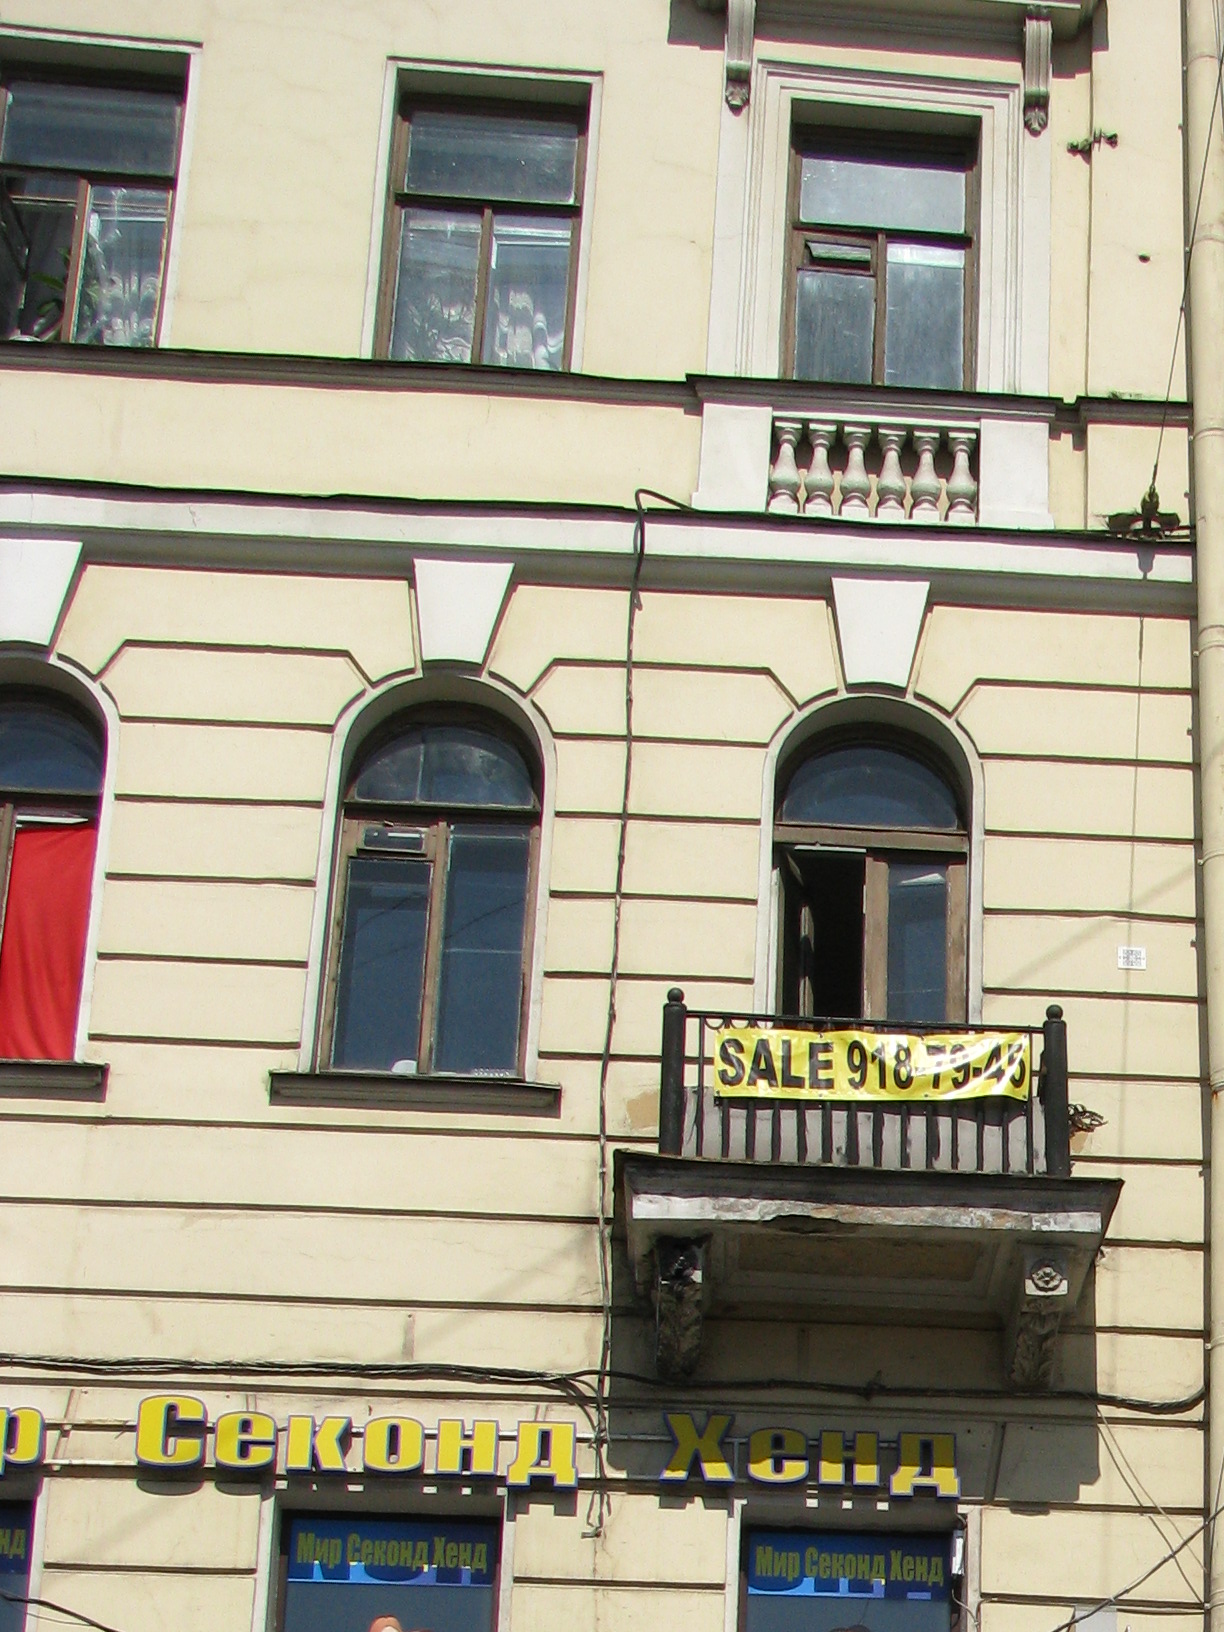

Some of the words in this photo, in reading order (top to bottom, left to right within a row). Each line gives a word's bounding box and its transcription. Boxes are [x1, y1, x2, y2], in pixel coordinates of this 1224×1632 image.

[718, 1038, 835, 1088] SALE
[136, 1394, 578, 1488] Секонд
[660, 1410, 961, 1498] Хенд
[297, 1532, 342, 1569] Мир
[346, 1533, 429, 1573] Секонд
[432, 1536, 487, 1572] Хенд
[755, 1545, 801, 1580] Мир
[804, 1546, 886, 1583] Секонд
[889, 1551, 944, 1587] Хенд
